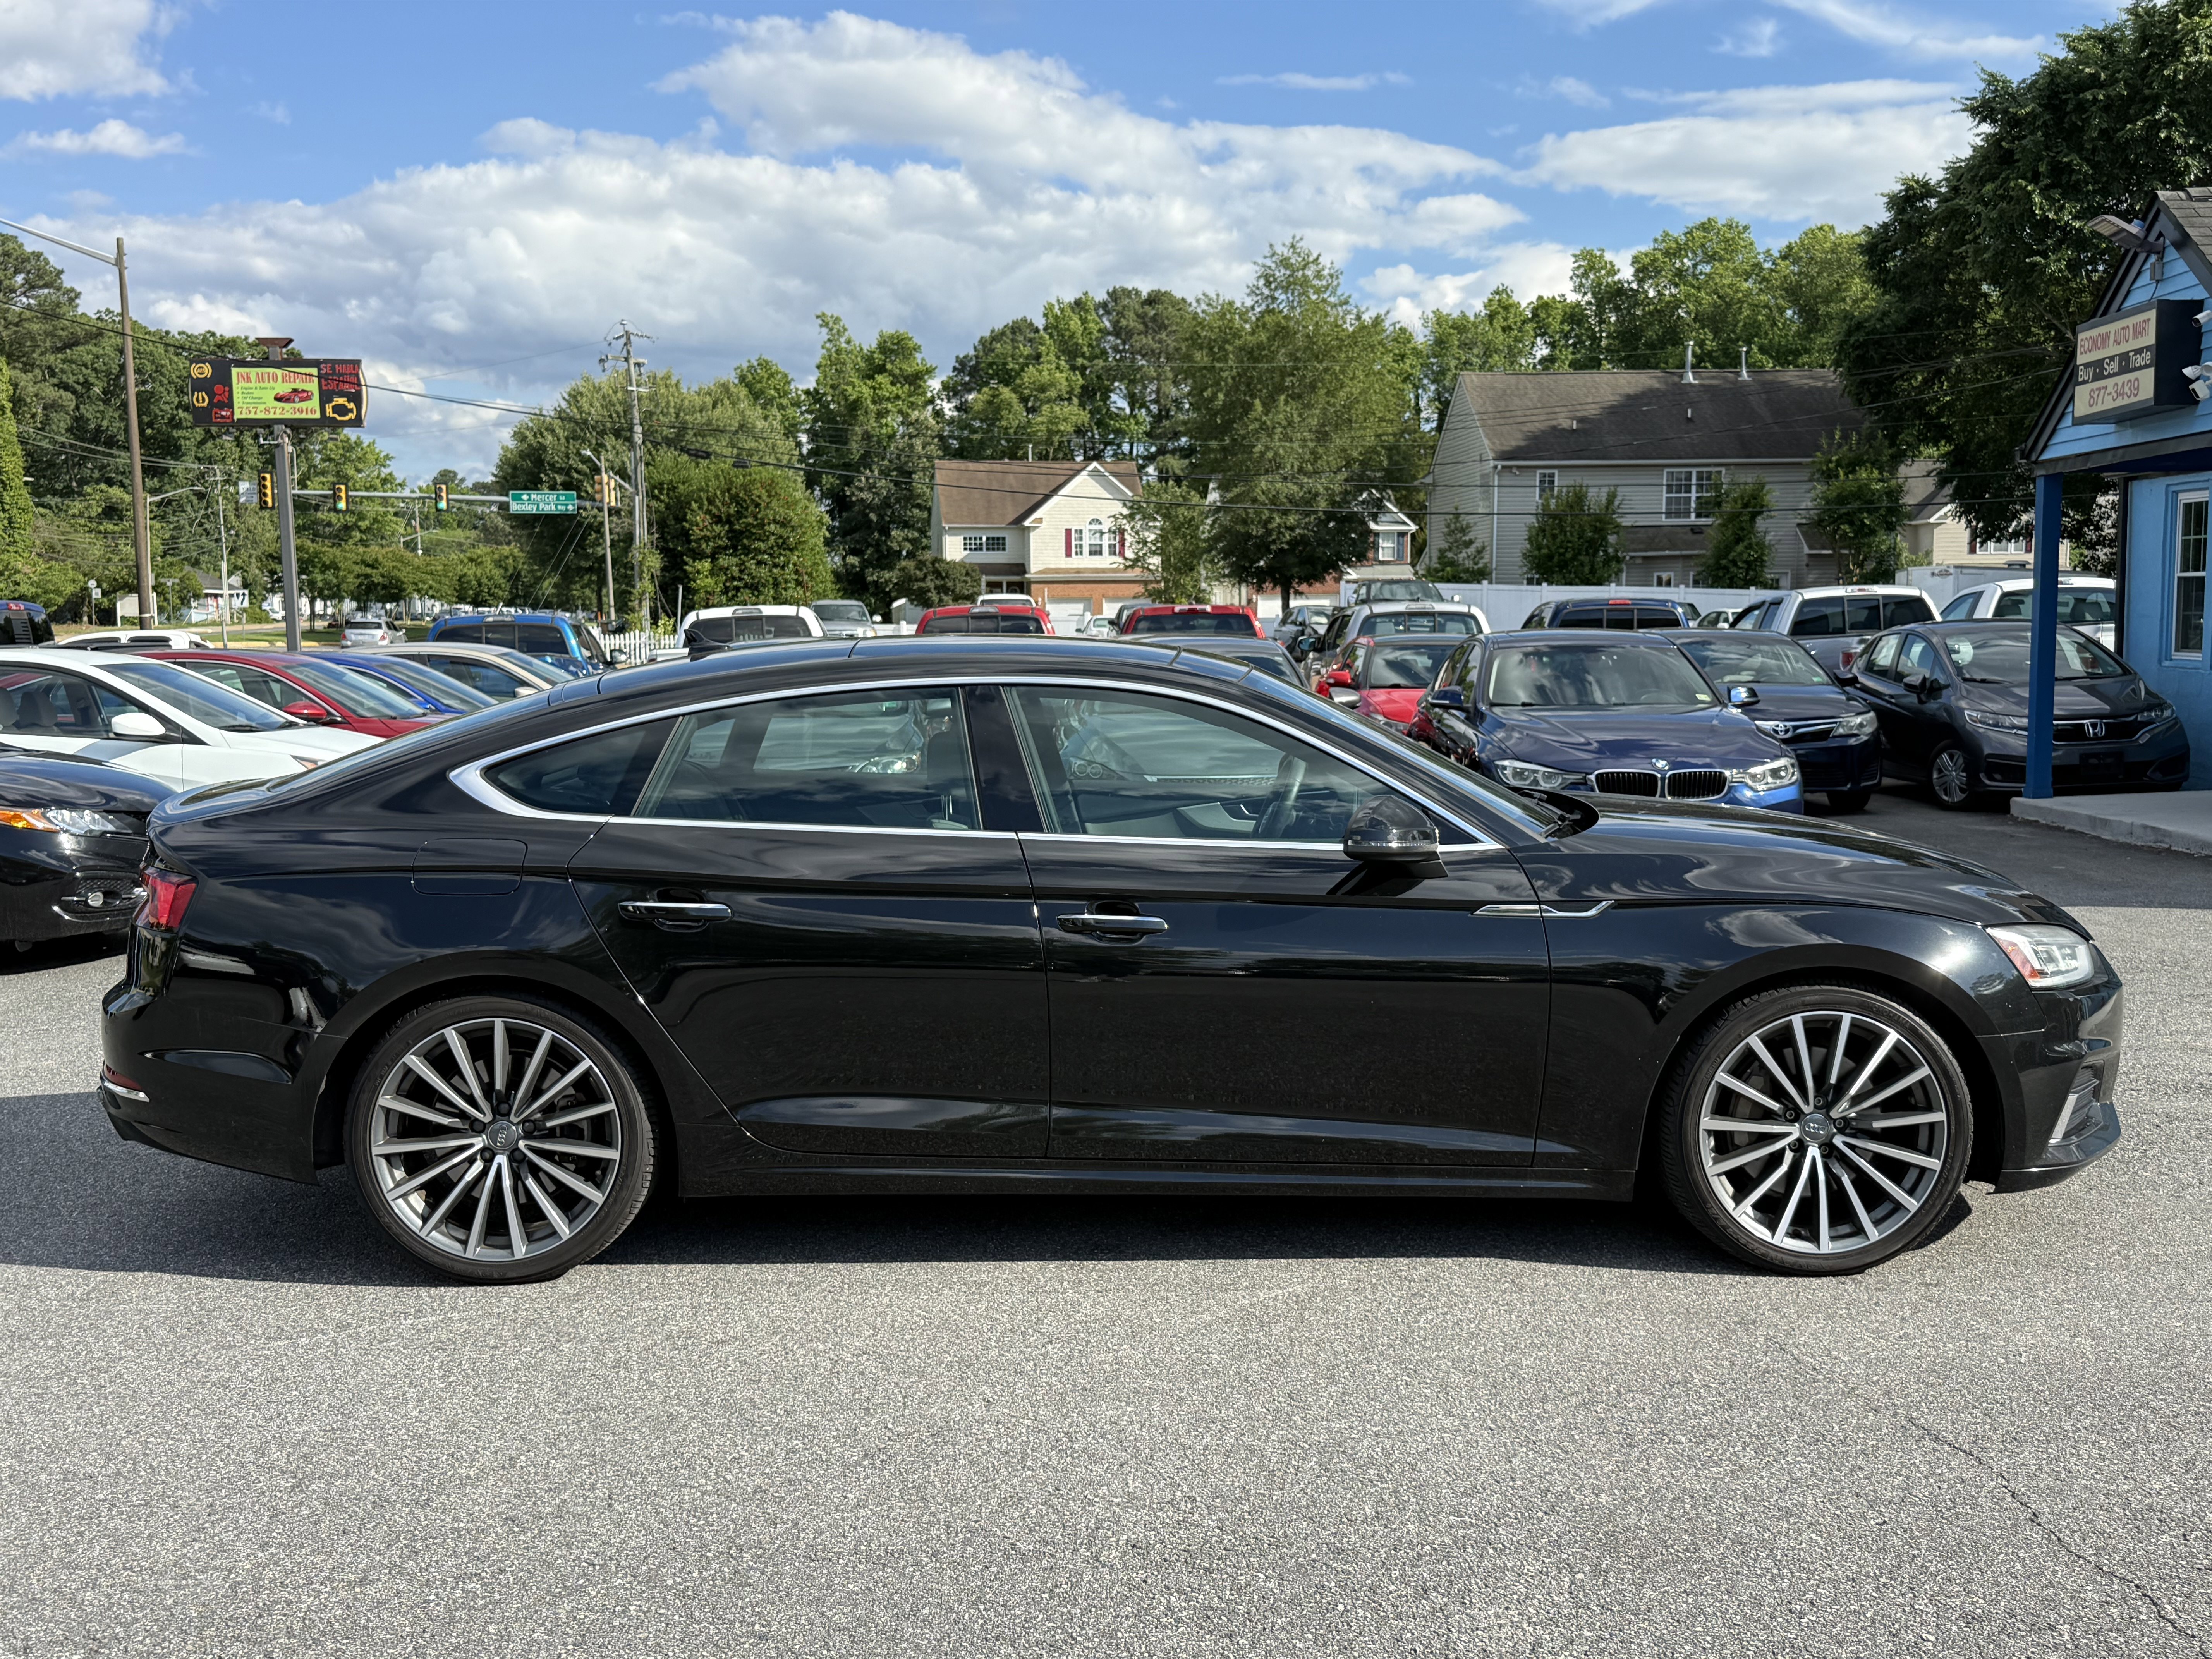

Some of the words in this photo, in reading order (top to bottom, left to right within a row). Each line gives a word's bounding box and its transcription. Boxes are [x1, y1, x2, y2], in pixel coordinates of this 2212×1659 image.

[2079, 330, 2111, 356] ECONOMY
[2113, 325, 2130, 346] AUTO
[2132, 318, 2151, 340] MART
[320, 364, 332, 374] SE
[2078, 365, 2094, 383] Buy
[2103, 356, 2118, 376] Sell
[2129, 349, 2151, 368] Trade
[236, 371, 252, 385] JNK
[255, 371, 278, 384] AUTO
[282, 371, 314, 384] REPAIR
[2088, 377, 2140, 408] 877-3439
[512, 503, 537, 512] Bexley
[539, 502, 556, 511] Park
